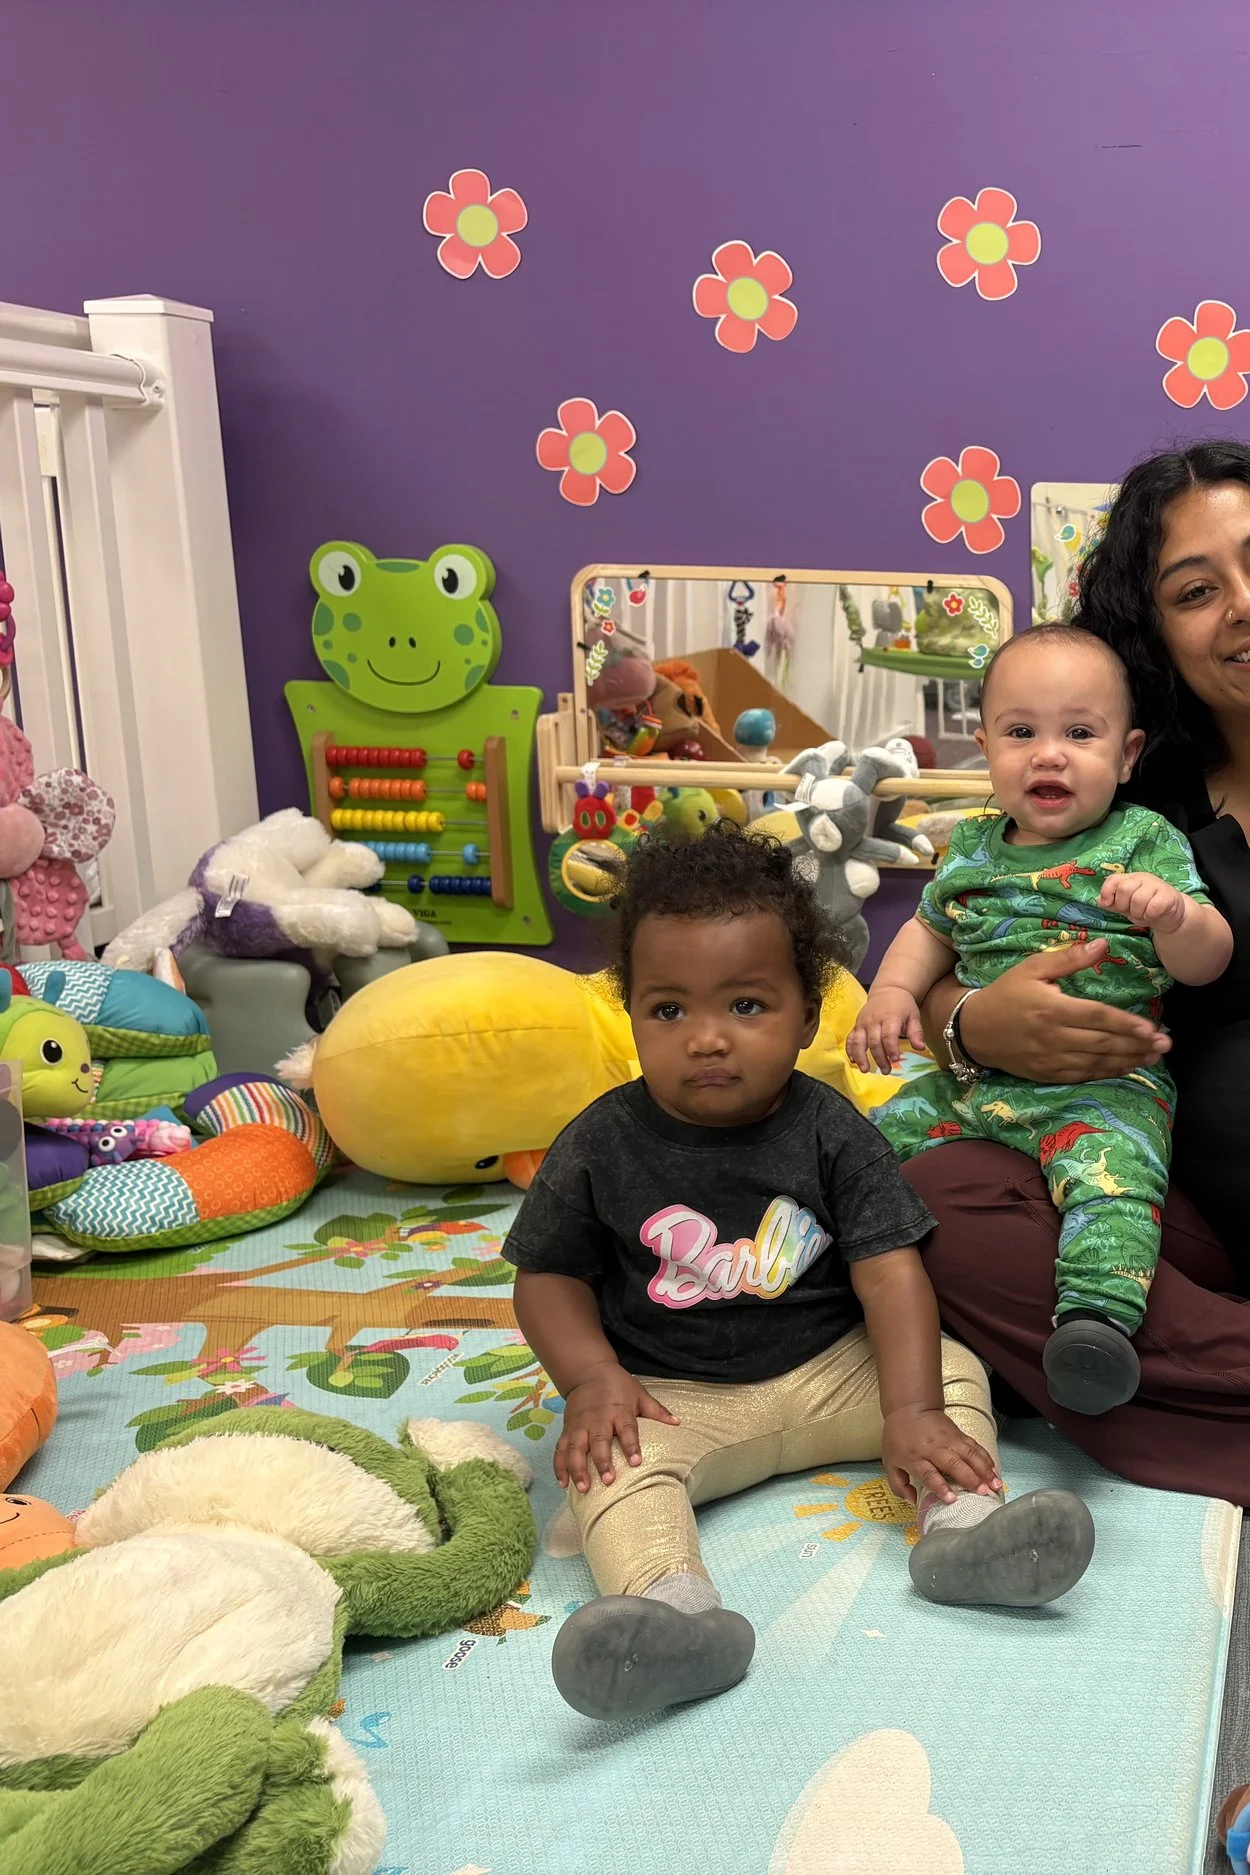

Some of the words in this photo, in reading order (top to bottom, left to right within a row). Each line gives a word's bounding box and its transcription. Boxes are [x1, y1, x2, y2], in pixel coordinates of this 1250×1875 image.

[642, 1199, 827, 1305] Barbie
[861, 1484, 895, 1521] TREES
[801, 1543, 818, 1558] sun
[445, 1639, 477, 1669] goose
